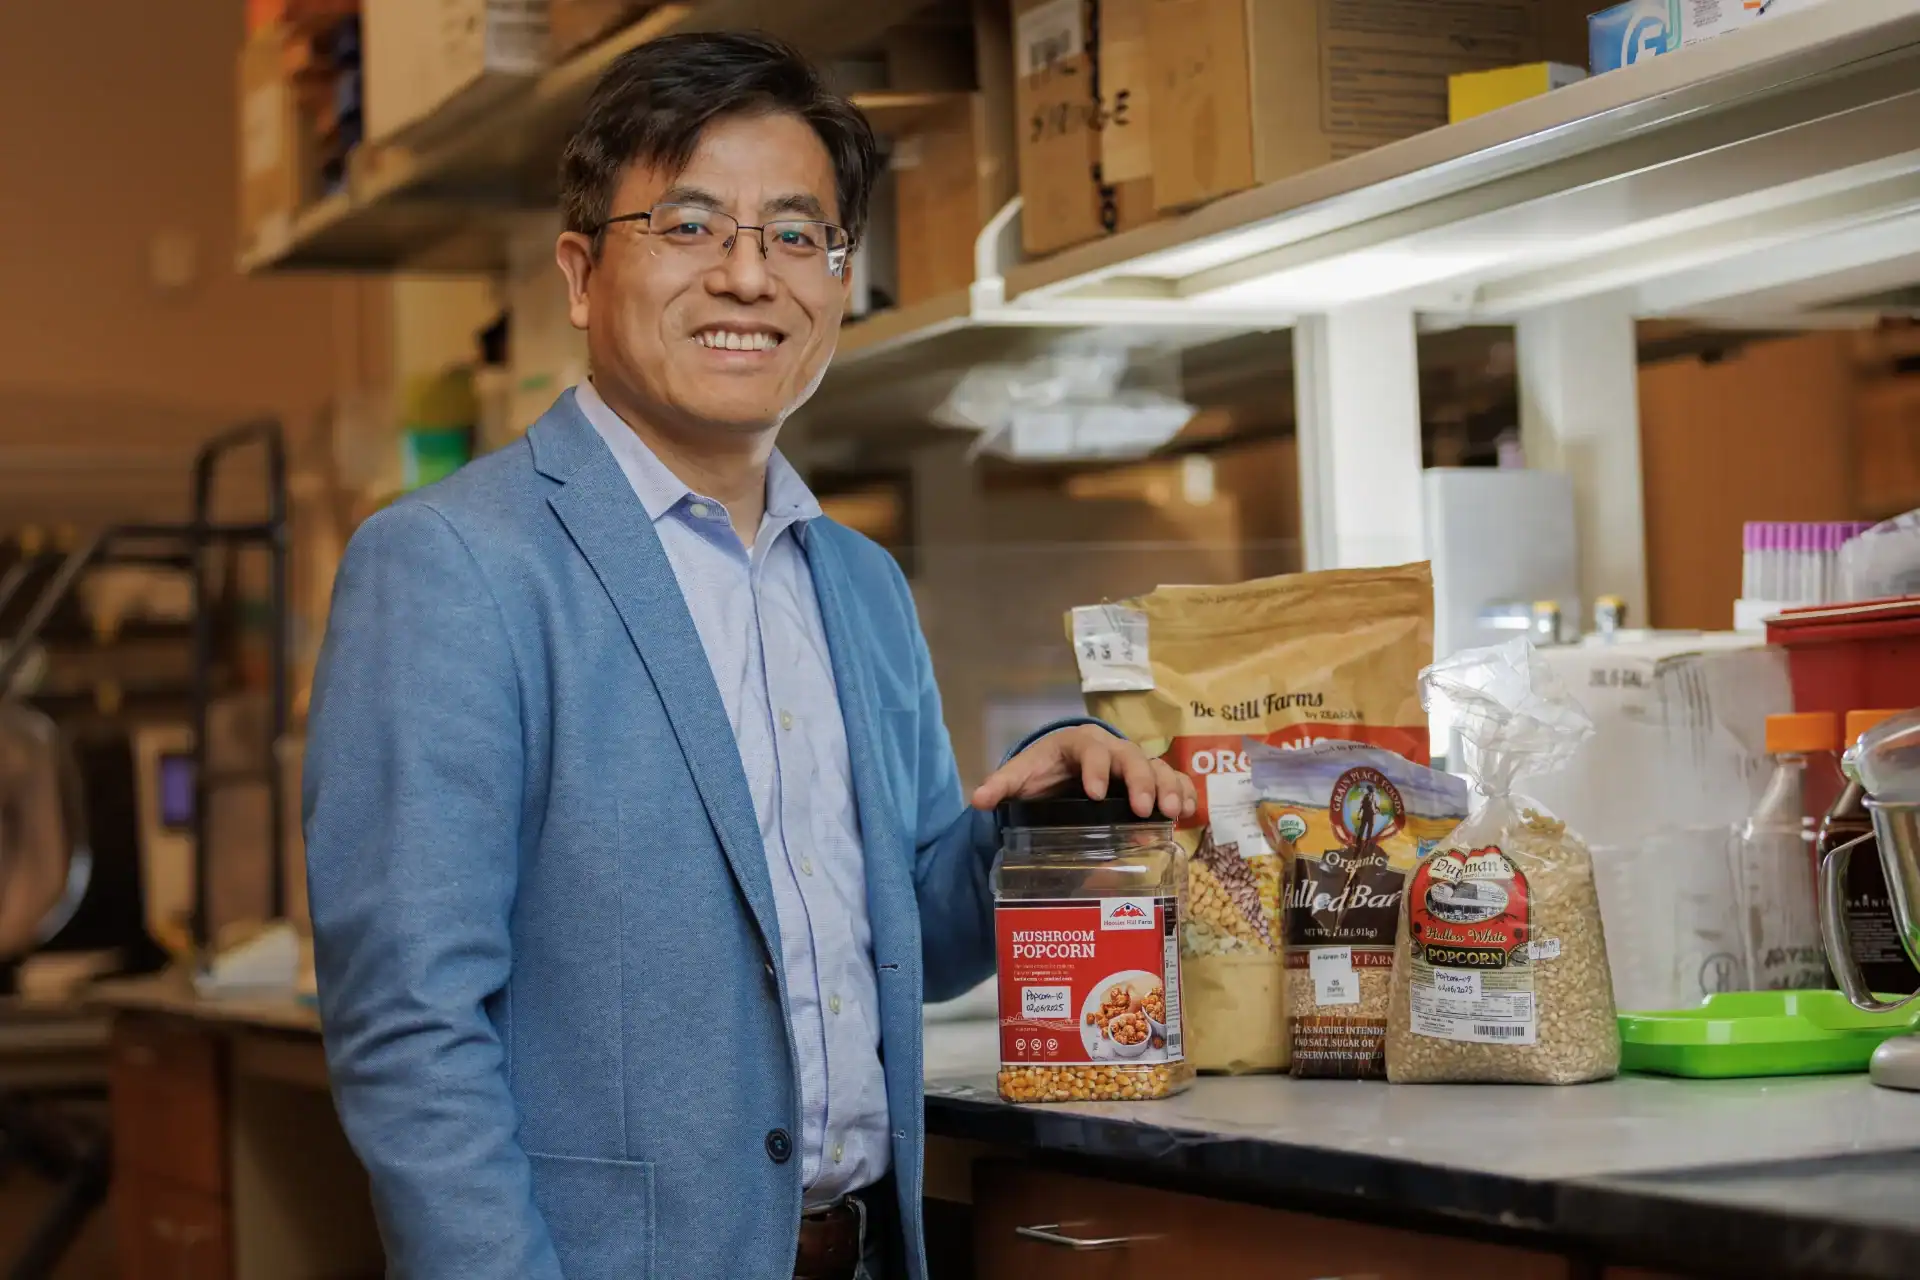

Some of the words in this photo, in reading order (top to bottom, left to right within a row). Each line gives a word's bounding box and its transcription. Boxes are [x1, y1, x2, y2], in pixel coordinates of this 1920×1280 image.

[1190, 700, 1215, 718] Be
[1221, 700, 1260, 722] Still
[1263, 692, 1324, 715] Farms
[1334, 777, 1351, 812] GRAIN
[1350, 770, 1380, 783] PLACE
[1381, 779, 1405, 815] FOODS
[1325, 852, 1387, 873] Organic
[1012, 930, 1095, 943] MUSHROOM
[1468, 927, 1507, 944] White
[1013, 943, 1096, 959] POPCORN
[1428, 948, 1503, 965] POPCORN
[1312, 1026, 1345, 1035] NATURE
[1308, 1038, 1331, 1048] SALT,
[1331, 1038, 1360, 1048] SUGAR
[1361, 1039, 1375, 1048] OR
[1354, 1051, 1384, 1060] ADDED
